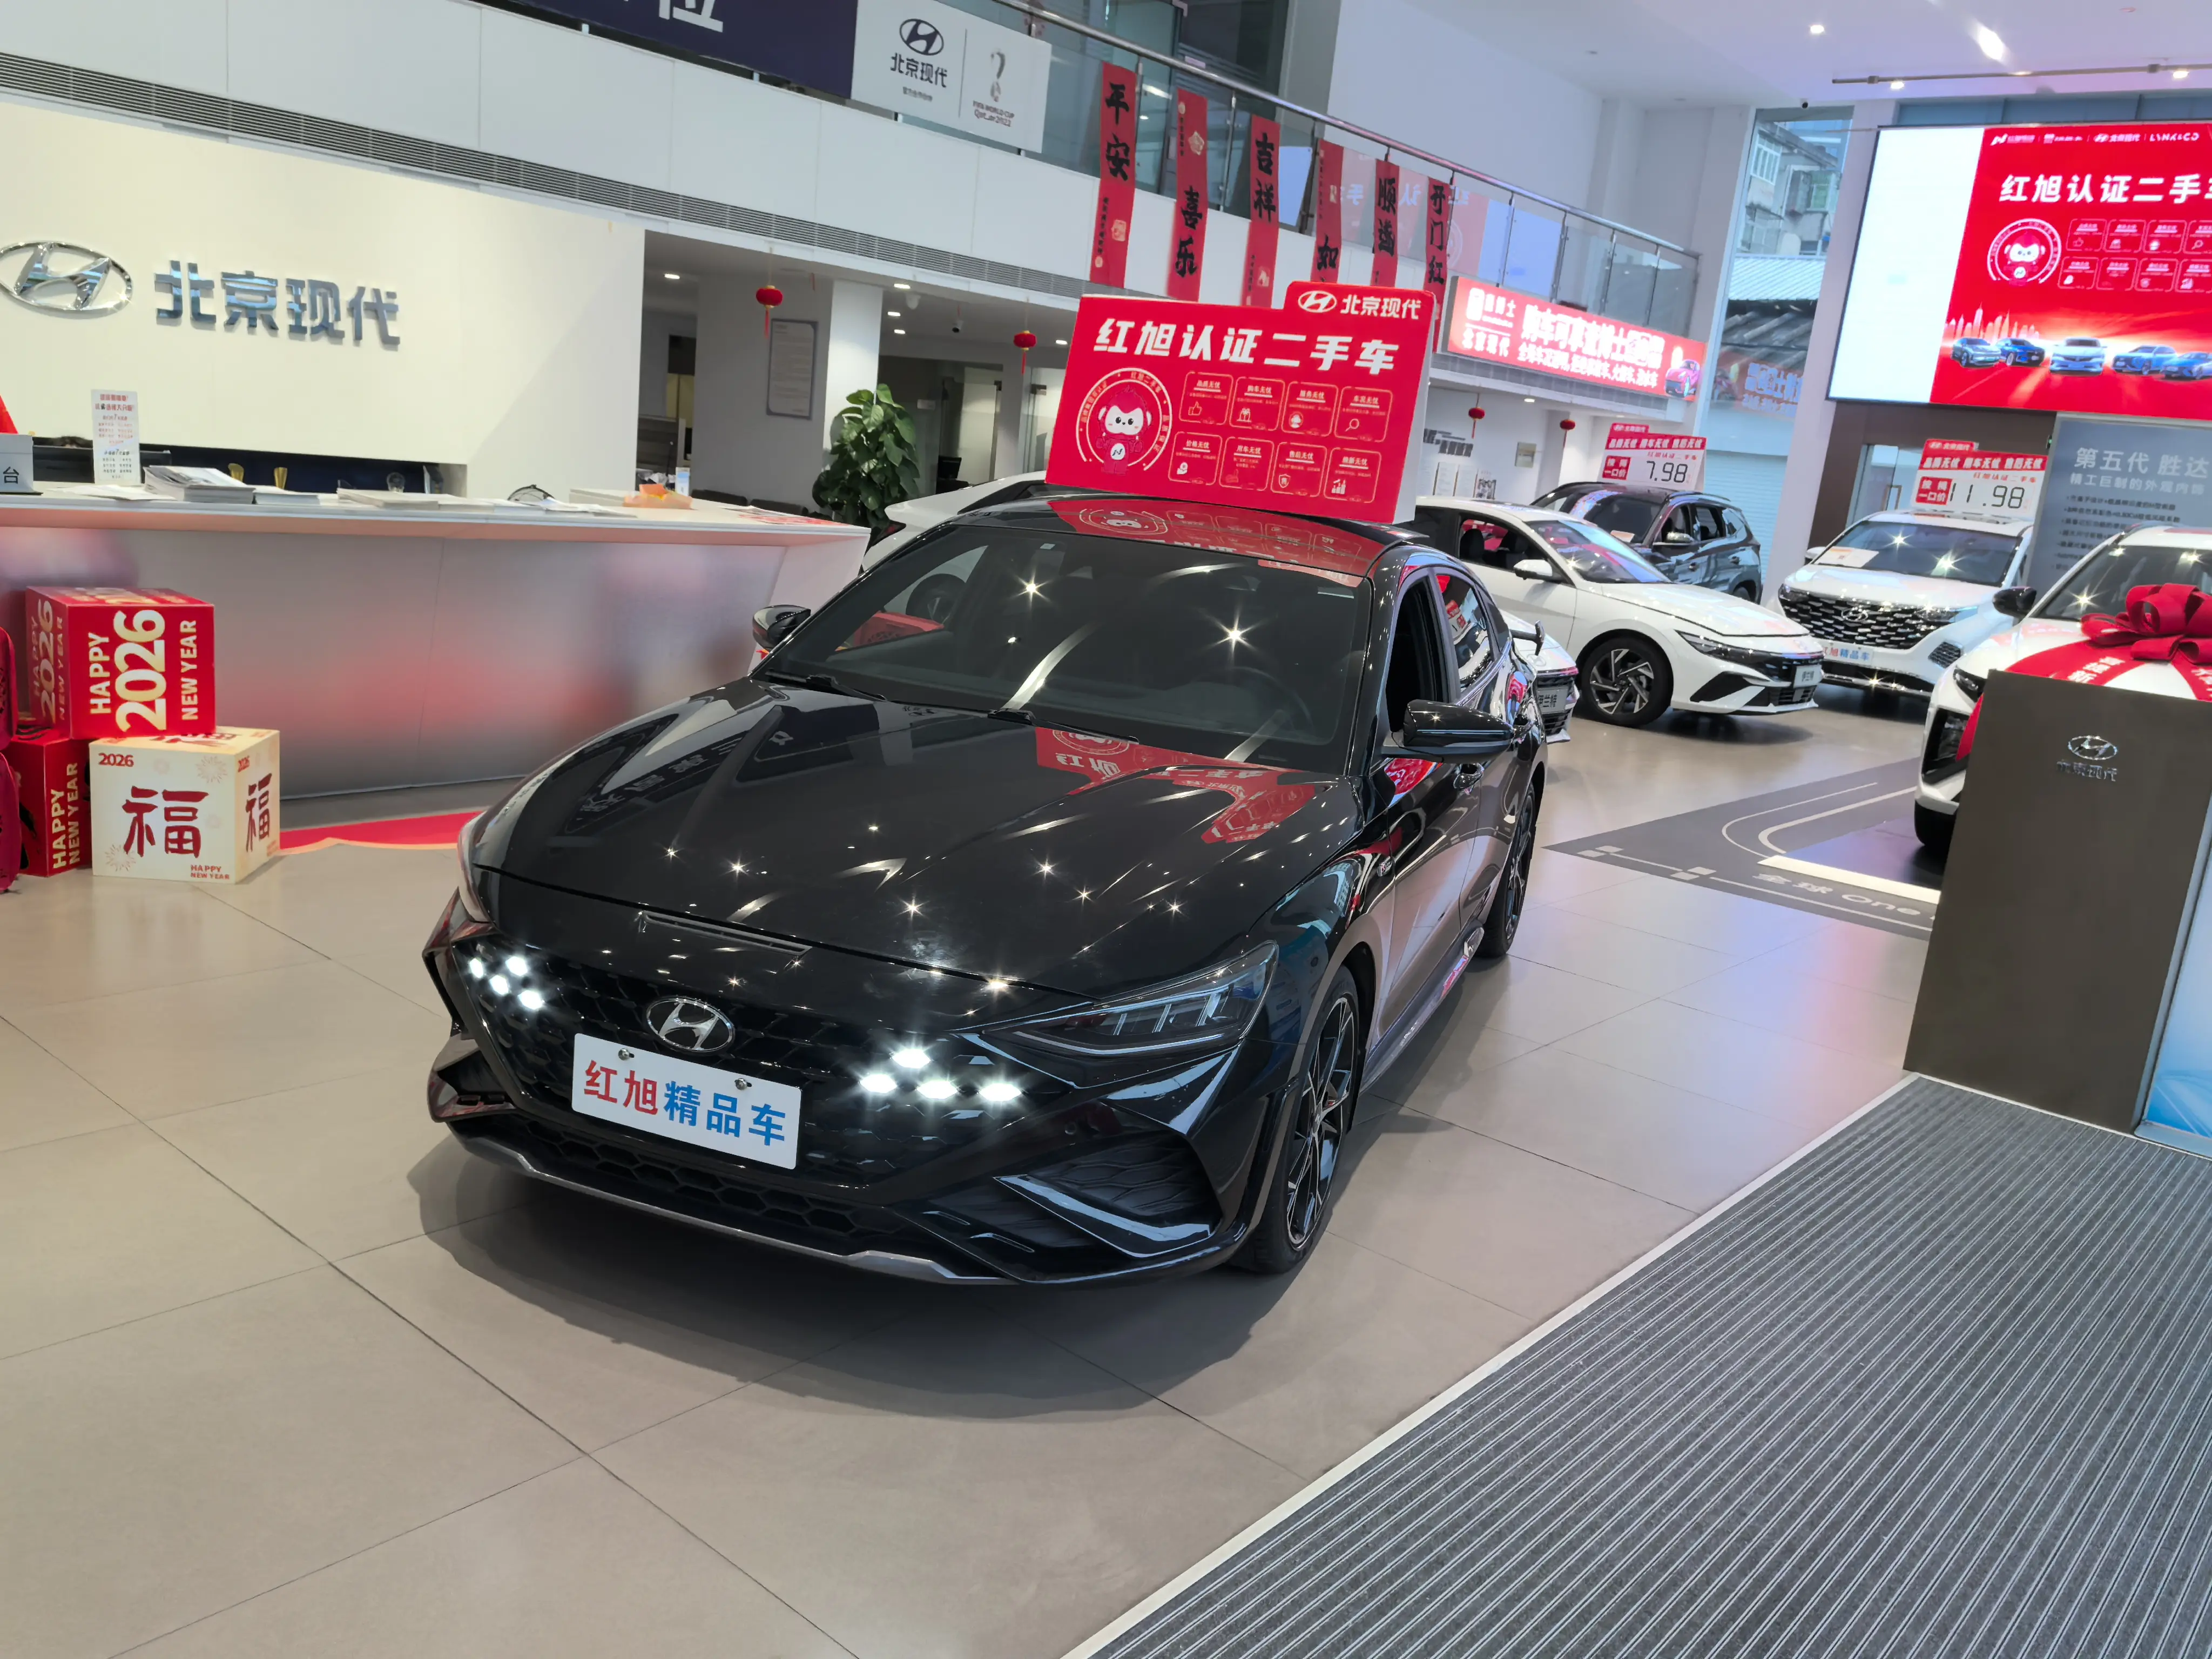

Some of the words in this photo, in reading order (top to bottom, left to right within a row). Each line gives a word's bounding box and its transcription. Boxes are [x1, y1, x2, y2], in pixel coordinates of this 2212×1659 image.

[891, 53, 947, 87] 北京现代
[1105, 83, 1130, 181] 平安
[1254, 132, 1276, 223] 吉祥
[1999, 173, 2212, 204] 红旭认证二手
[1174, 190, 1203, 278] 喜乐
[1429, 185, 1446, 285] 开门红
[154, 260, 400, 346] 北京现代
[1340, 294, 1421, 321] 北京现代
[1093, 318, 1399, 375] 红旭认证二手车
[3, 467, 19, 484] 台
[1647, 461, 1688, 483] 7.98
[2074, 447, 2149, 474] 第五代
[2157, 454, 2209, 478] 胜达
[1950, 483, 2025, 508] 11.98
[38, 598, 56, 724] 2026
[88, 632, 111, 714] HAPPY
[113, 609, 167, 732] 2026
[180, 620, 197, 673] YEAR
[181, 677, 198, 720] NEW
[98, 753, 134, 767] 2026
[66, 763, 78, 817] YEAR
[246, 773, 272, 852] 福
[51, 789, 66, 869] HAPPY
[68, 821, 80, 864] NEW
[122, 786, 208, 858] 福
[191, 865, 221, 873] HAPPY
[1842, 894, 1921, 915] One
[584, 1060, 786, 1147] 红旭精品车
